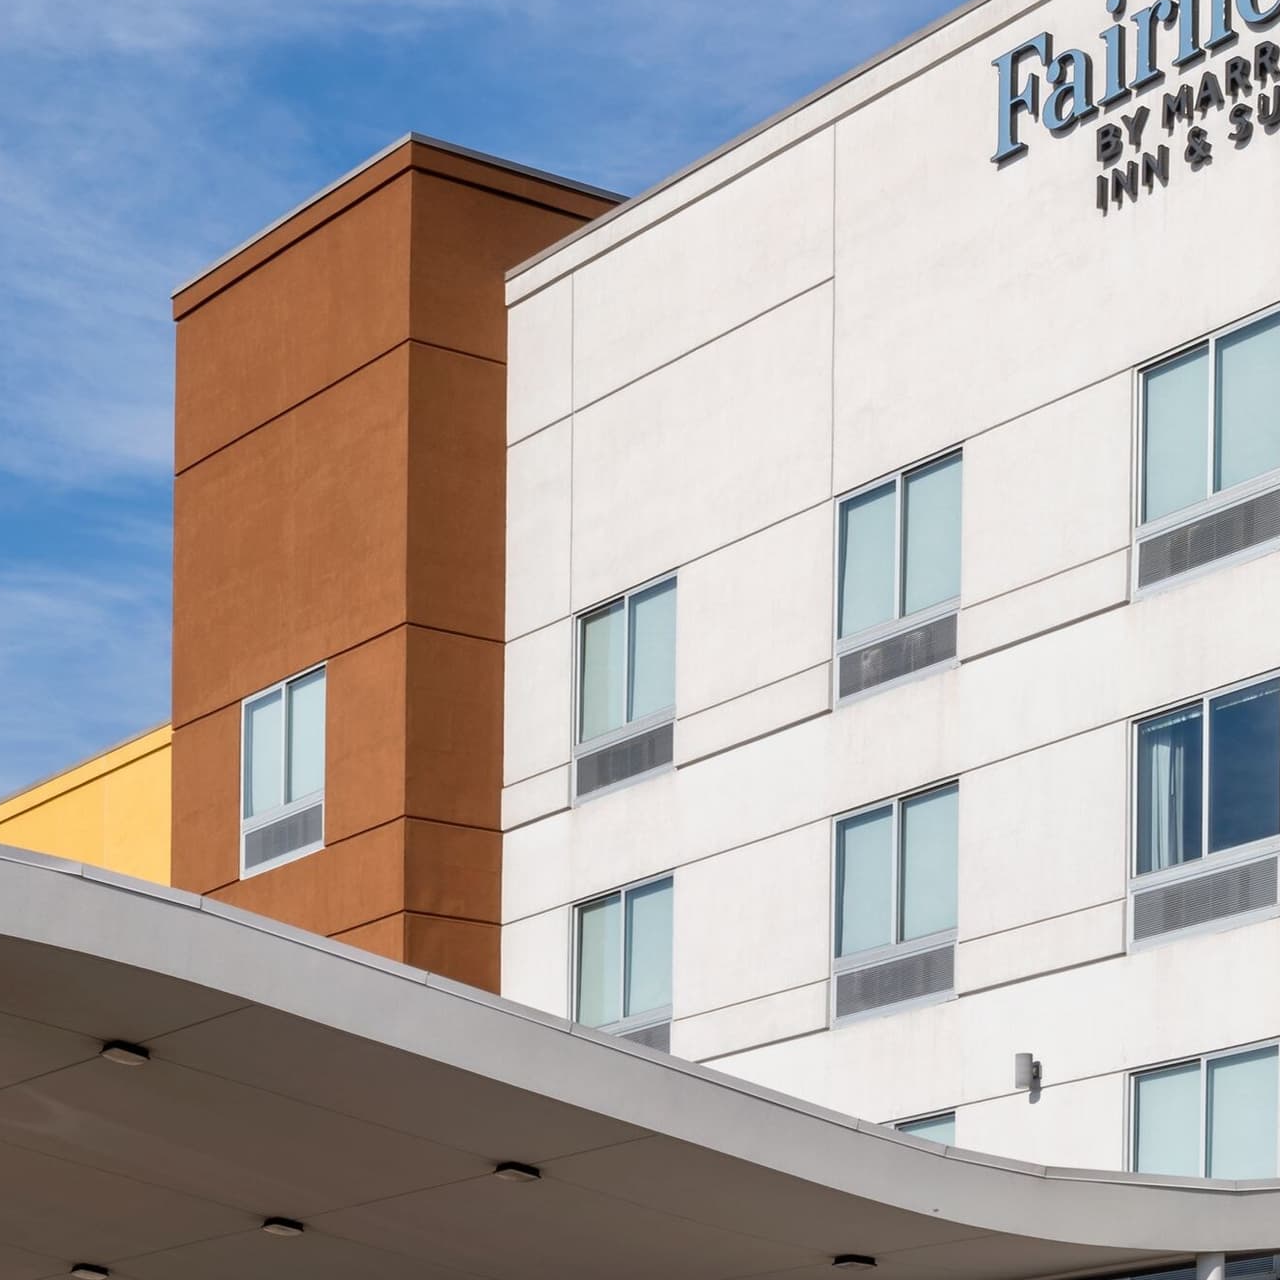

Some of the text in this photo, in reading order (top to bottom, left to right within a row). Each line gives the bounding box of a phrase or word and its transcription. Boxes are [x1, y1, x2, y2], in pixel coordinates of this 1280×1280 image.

[1096, 106, 1150, 165] BY
[1096, 144, 1170, 211] INN
[1184, 126, 1213, 168] &
